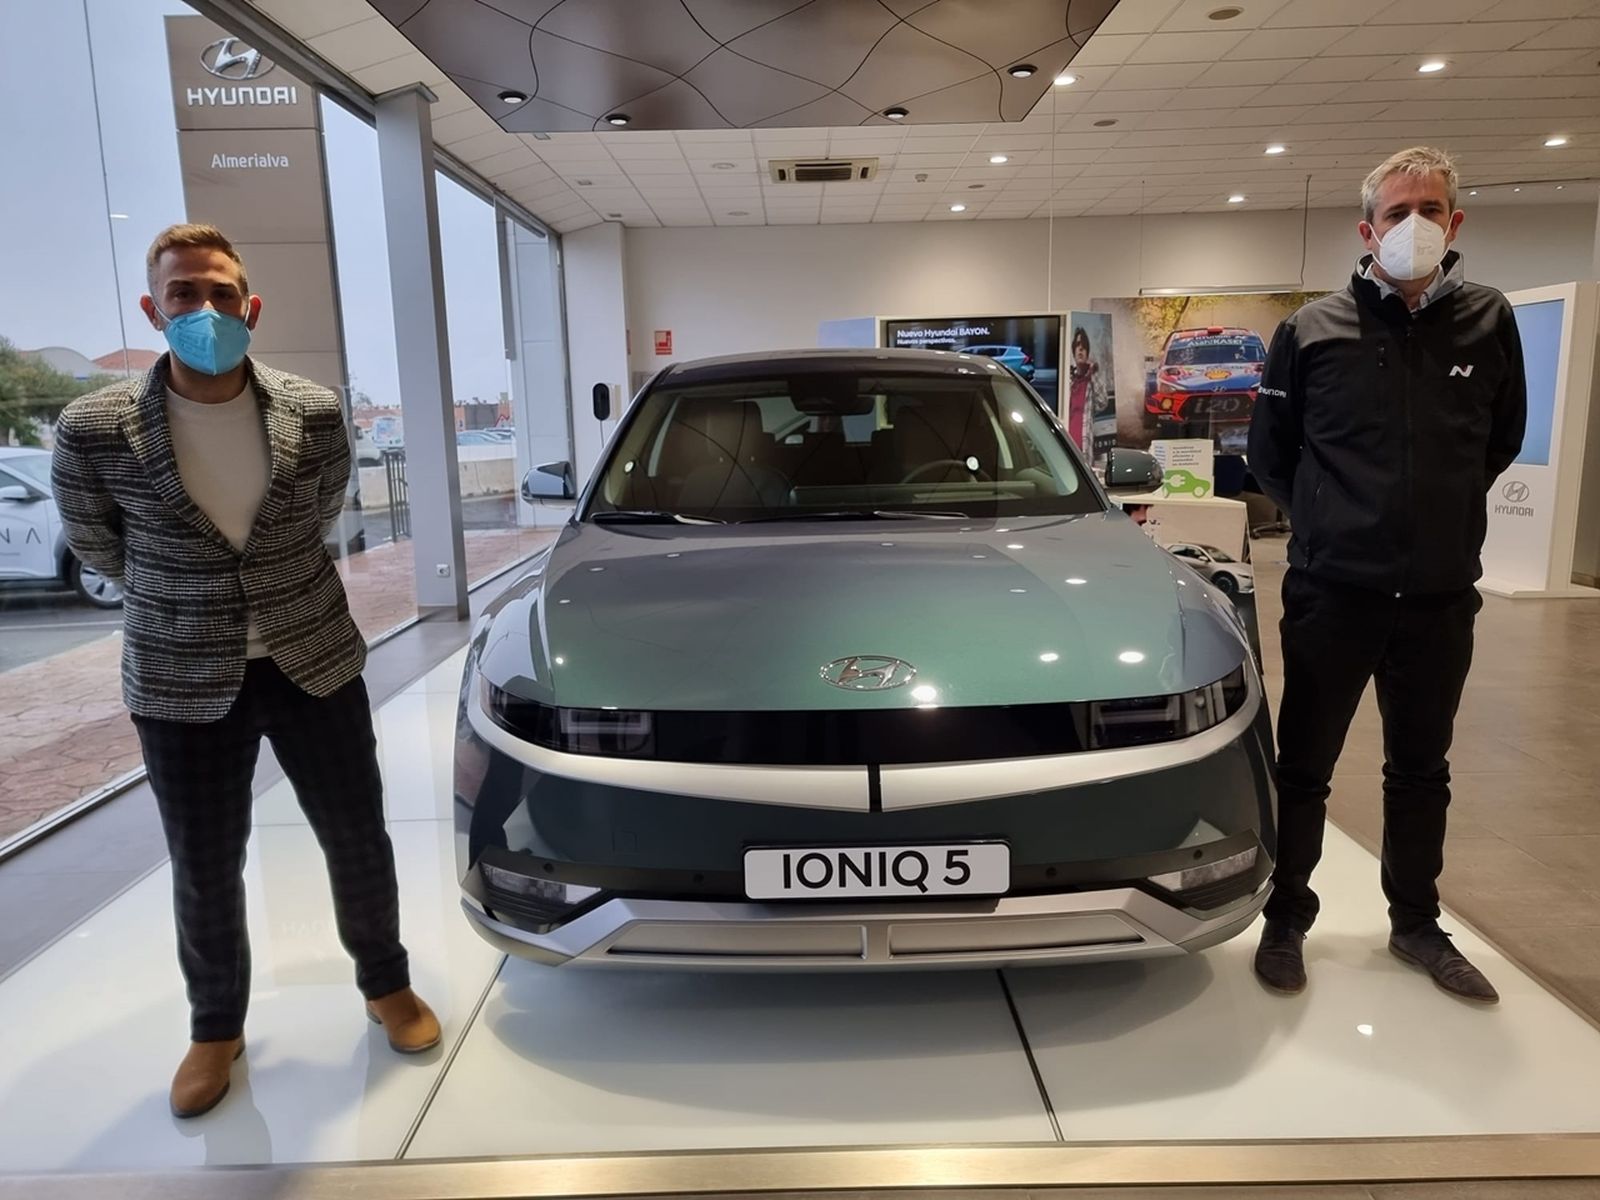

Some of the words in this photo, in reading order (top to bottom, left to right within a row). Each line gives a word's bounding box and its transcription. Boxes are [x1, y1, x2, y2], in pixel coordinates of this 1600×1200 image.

[186, 86, 298, 106] HYUNDAI
[211, 152, 289, 169] Almerialva
[897, 329, 923, 338] Nuevo
[924, 328, 958, 338] Hyundai
[959, 327, 990, 337] BAYON.
[1494, 504, 1535, 517] HYUNDAI
[782, 850, 929, 894] IONIQ
[943, 849, 971, 886] 5
